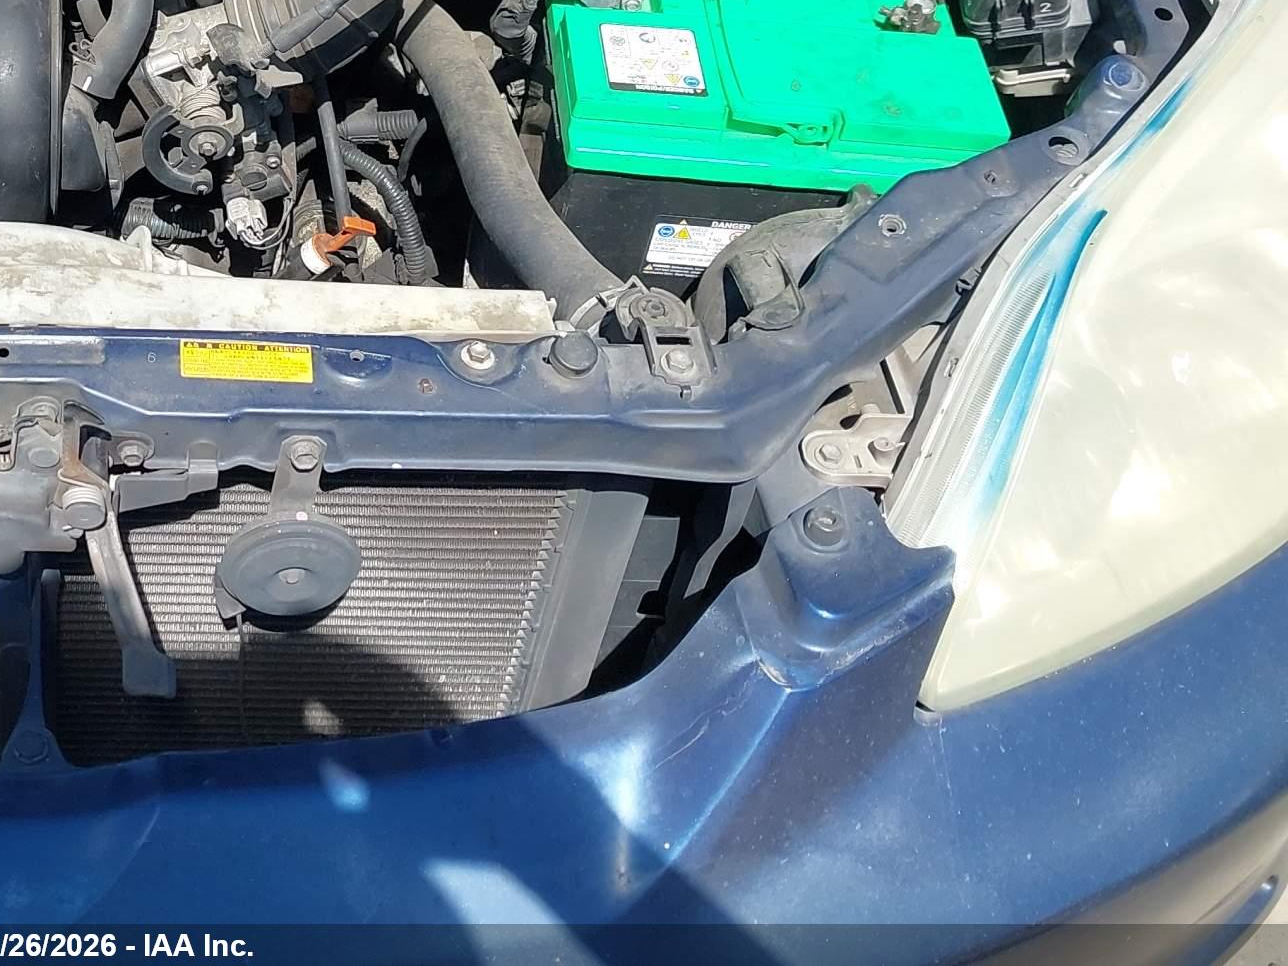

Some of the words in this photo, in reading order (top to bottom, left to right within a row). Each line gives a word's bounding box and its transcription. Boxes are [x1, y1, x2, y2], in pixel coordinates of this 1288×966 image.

[1039, 2, 1052, 13] 2
[711, 221, 752, 230] DANGER
[218, 343, 258, 352] CAUTION
[264, 345, 308, 354] ATTENTION
